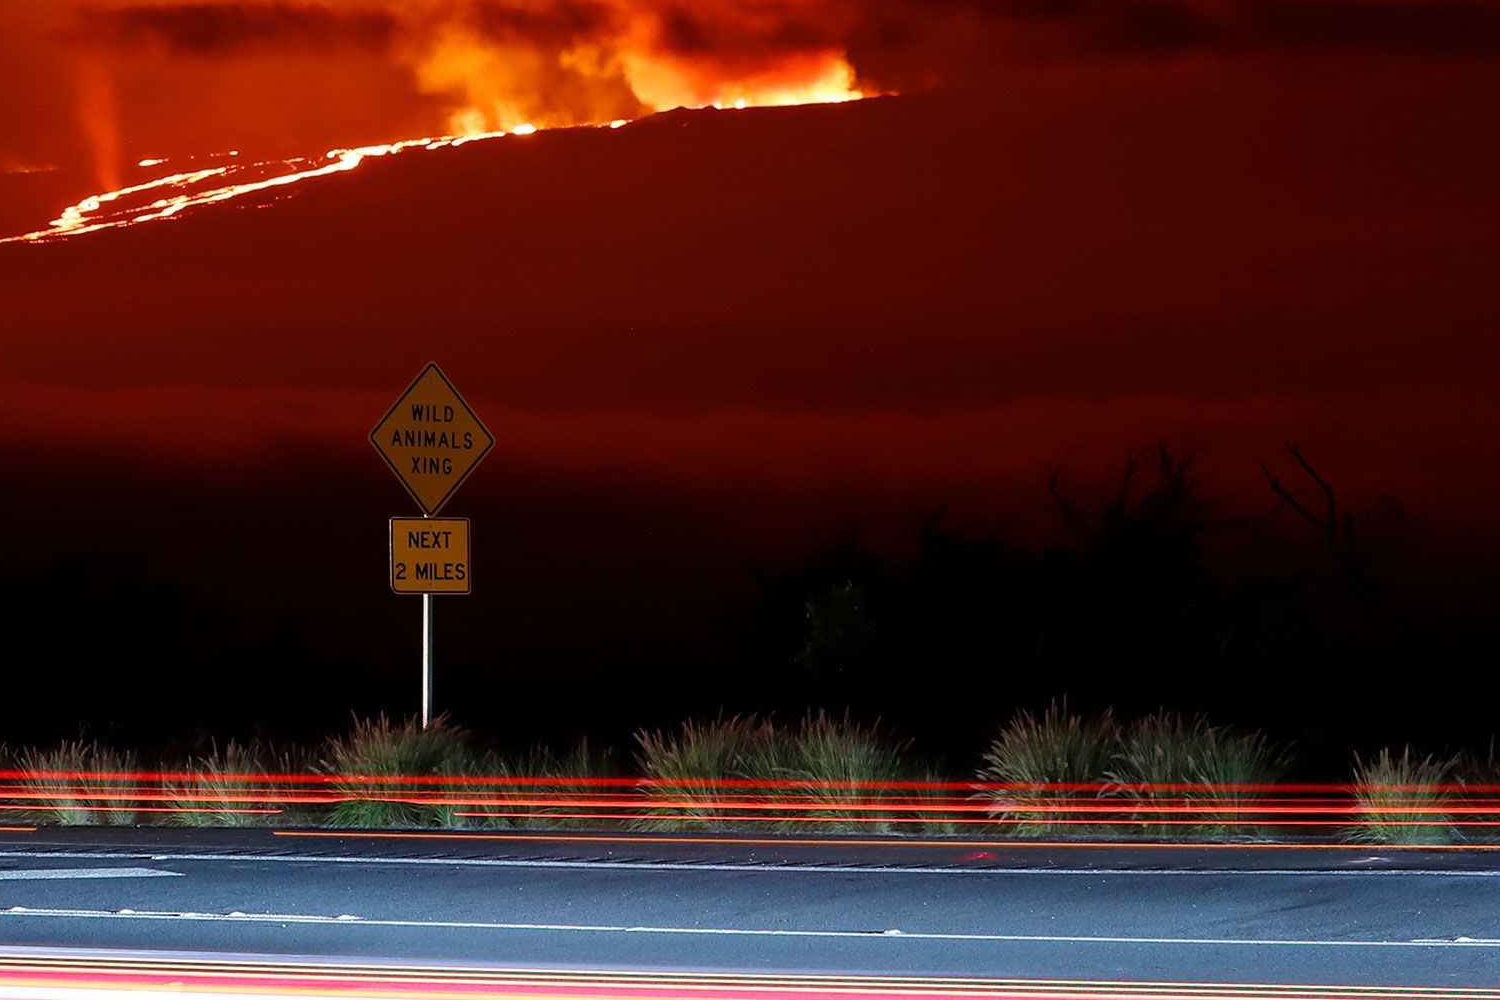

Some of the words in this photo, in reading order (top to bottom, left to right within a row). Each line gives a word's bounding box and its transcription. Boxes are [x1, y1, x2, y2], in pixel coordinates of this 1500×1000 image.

[411, 404, 454, 423] WILD
[391, 429, 473, 450] ANIMALS
[411, 457, 452, 475] XING
[408, 531, 451, 548] NEXT
[395, 563, 407, 580] 2
[415, 563, 466, 581] MILES
